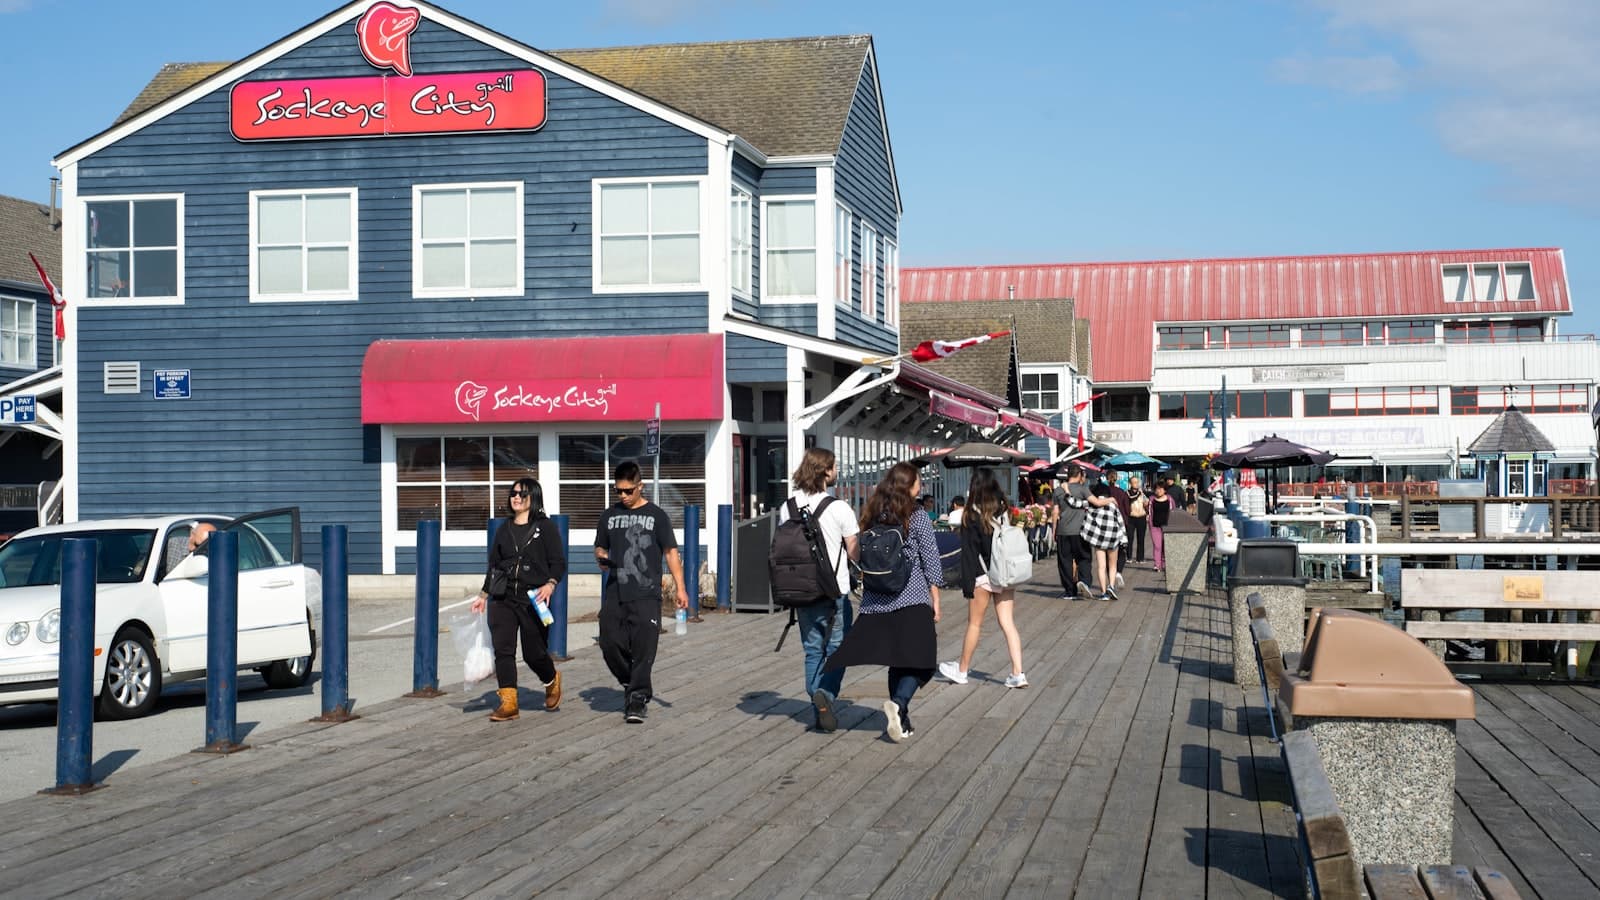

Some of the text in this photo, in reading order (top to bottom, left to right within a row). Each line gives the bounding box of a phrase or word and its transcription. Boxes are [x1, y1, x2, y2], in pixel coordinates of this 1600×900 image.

[252, 75, 513, 128] Sockeye City grill
[15, 405, 34, 413] HERE
[492, 383, 617, 415] Sockeye City grill
[0, 400, 13, 420] P
[607, 515, 656, 531] STRONG
